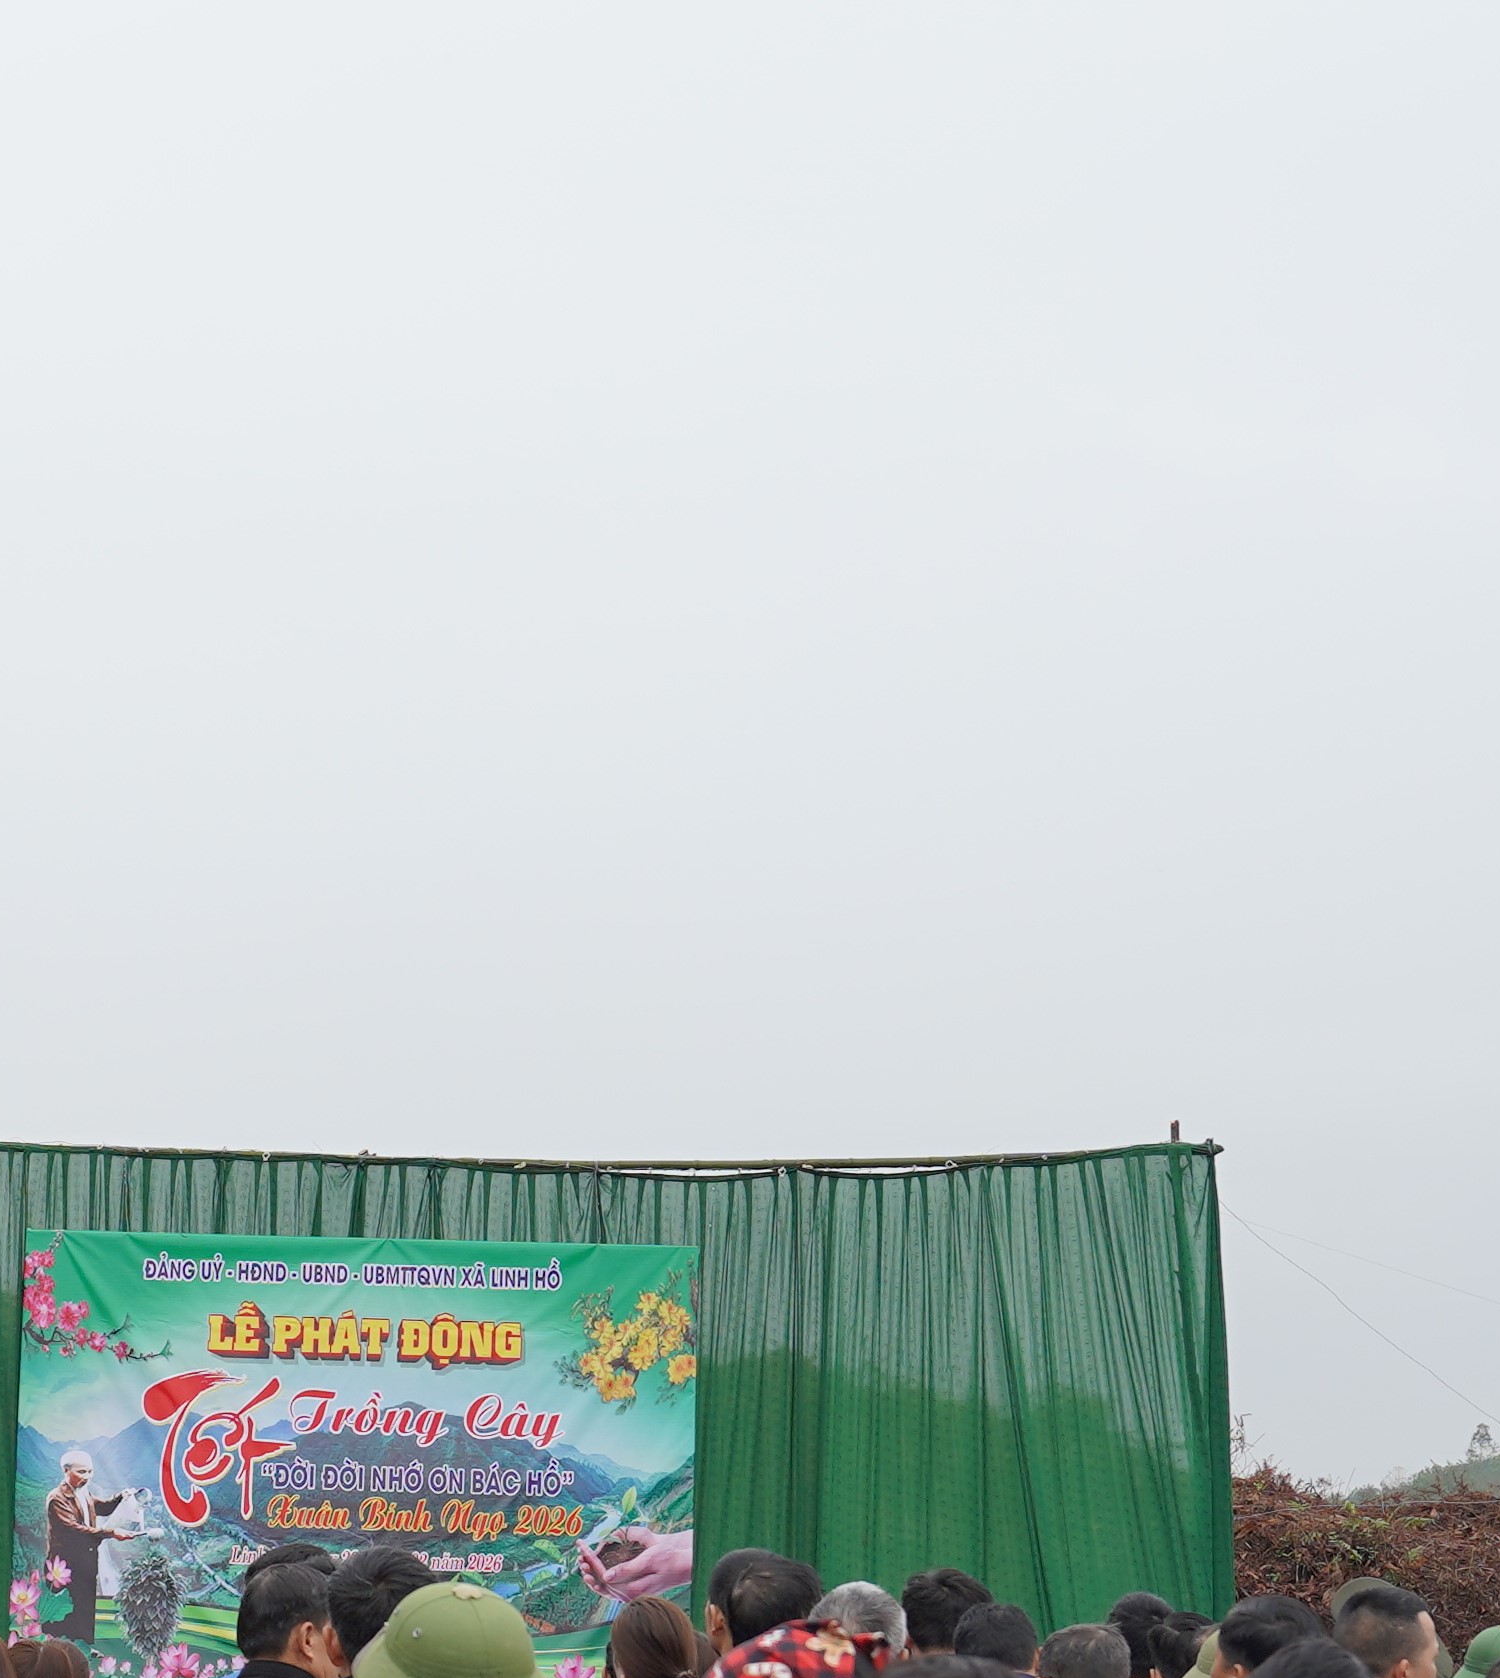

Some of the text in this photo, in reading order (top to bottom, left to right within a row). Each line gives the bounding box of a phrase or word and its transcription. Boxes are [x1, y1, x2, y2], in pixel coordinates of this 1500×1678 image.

[143, 1252, 197, 1280] ĐẢNG
[199, 1253, 225, 1281] UỶ
[236, 1261, 287, 1284] HĐND
[301, 1263, 349, 1286] UBND
[363, 1264, 455, 1288] UBMTTQVN
[459, 1262, 485, 1290] XÃ
[489, 1266, 529, 1290] LINH
[532, 1257, 562, 1291] HỒ
[208, 1301, 524, 1369] LỄ PHÁT ĐỘNG
[290, 1388, 566, 1448] Trồng Cây
[322, 1457, 365, 1492] ĐỜI
[371, 1457, 424, 1493] NHỚ
[430, 1461, 465, 1494] ƠN
[470, 1461, 521, 1496] BÁC
[267, 1494, 351, 1529] Xuân
[441, 1499, 507, 1541] Ngọ
[513, 1504, 584, 1536] 2026
[429, 1551, 465, 1571] năm
[466, 1552, 504, 1573] 2026
